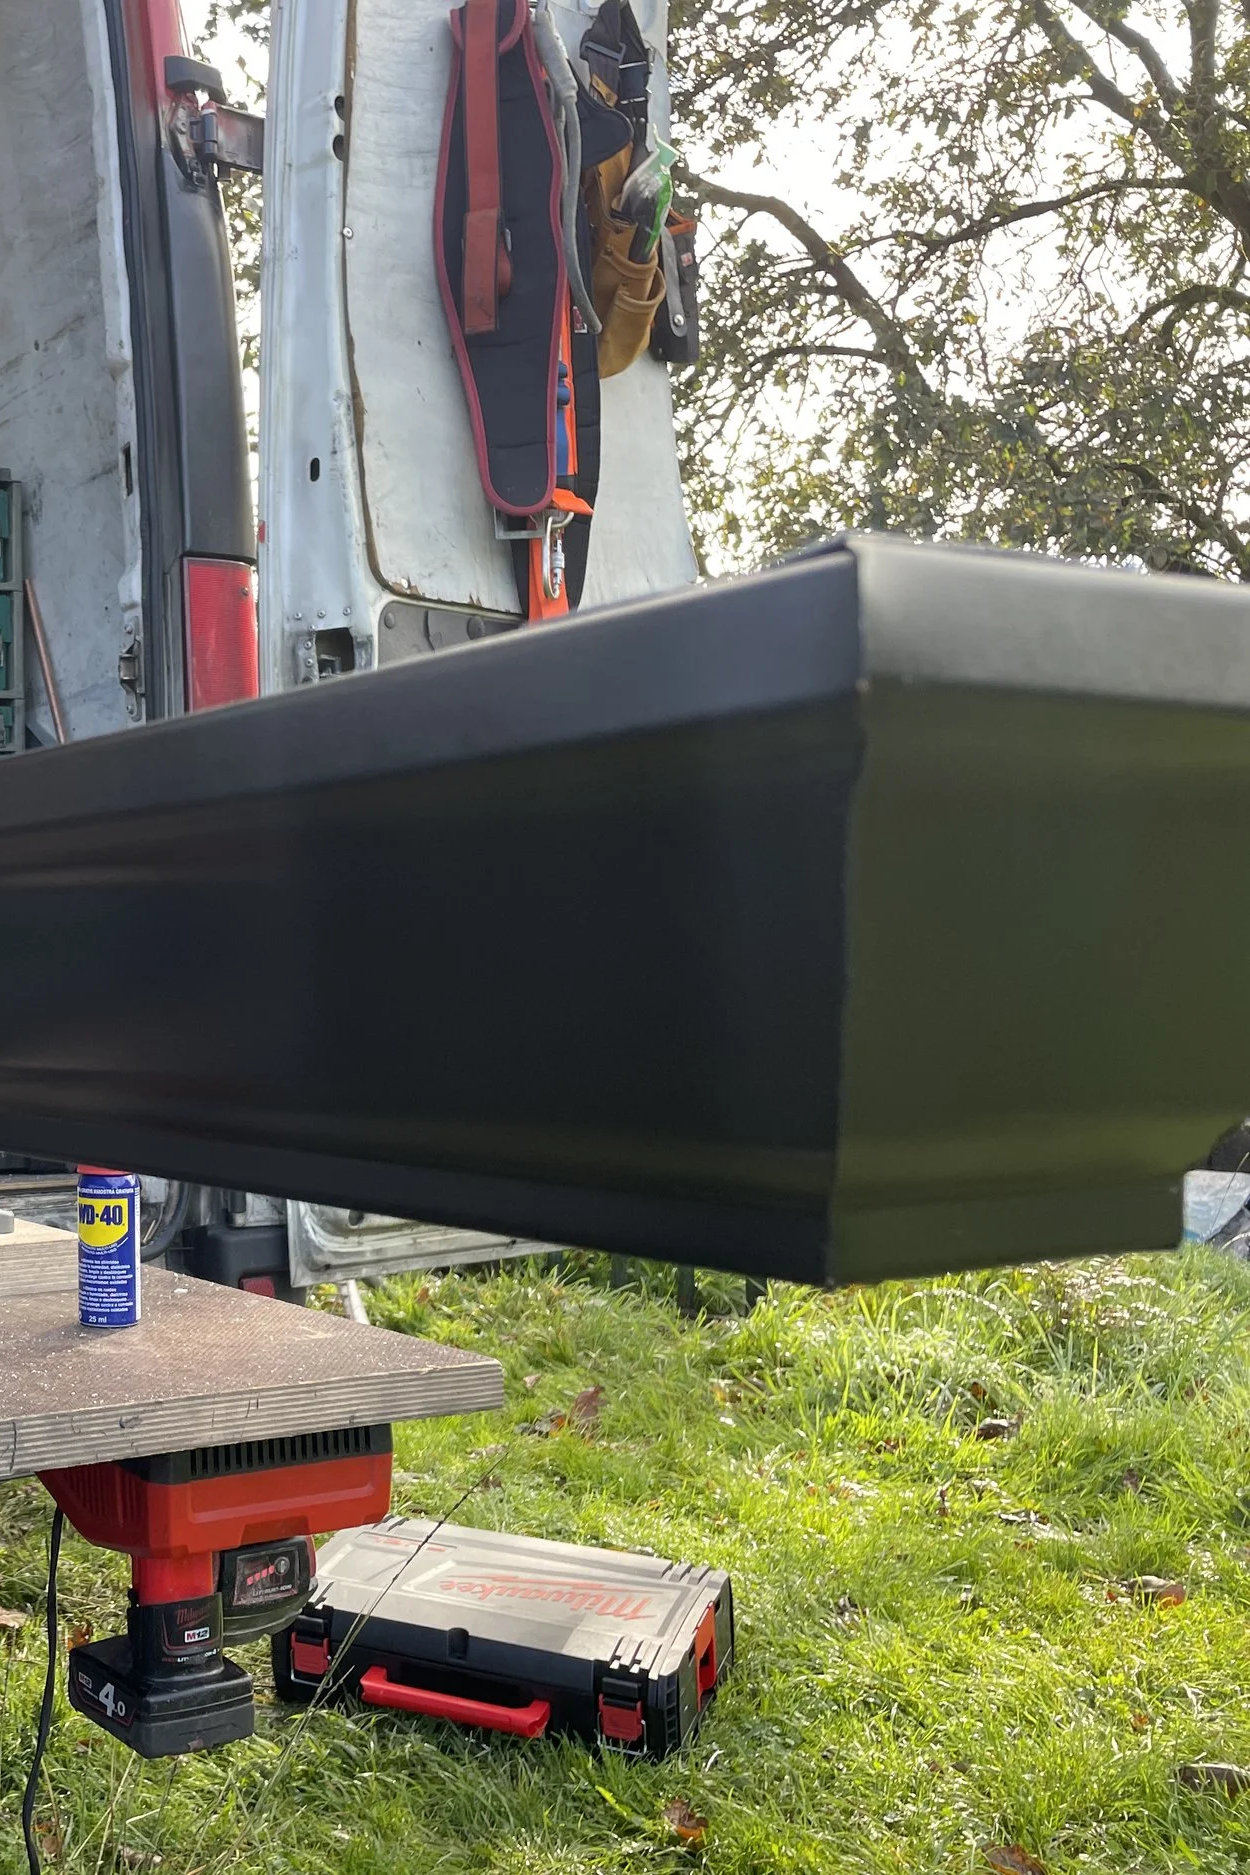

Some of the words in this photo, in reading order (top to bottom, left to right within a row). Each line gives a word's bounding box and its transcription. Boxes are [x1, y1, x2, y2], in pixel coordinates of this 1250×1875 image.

[79, 1203, 123, 1226] WD-40
[439, 1579, 657, 1622] Milwaukee
[186, 1630, 208, 1640] M12
[98, 1682, 126, 1717] 4.0
